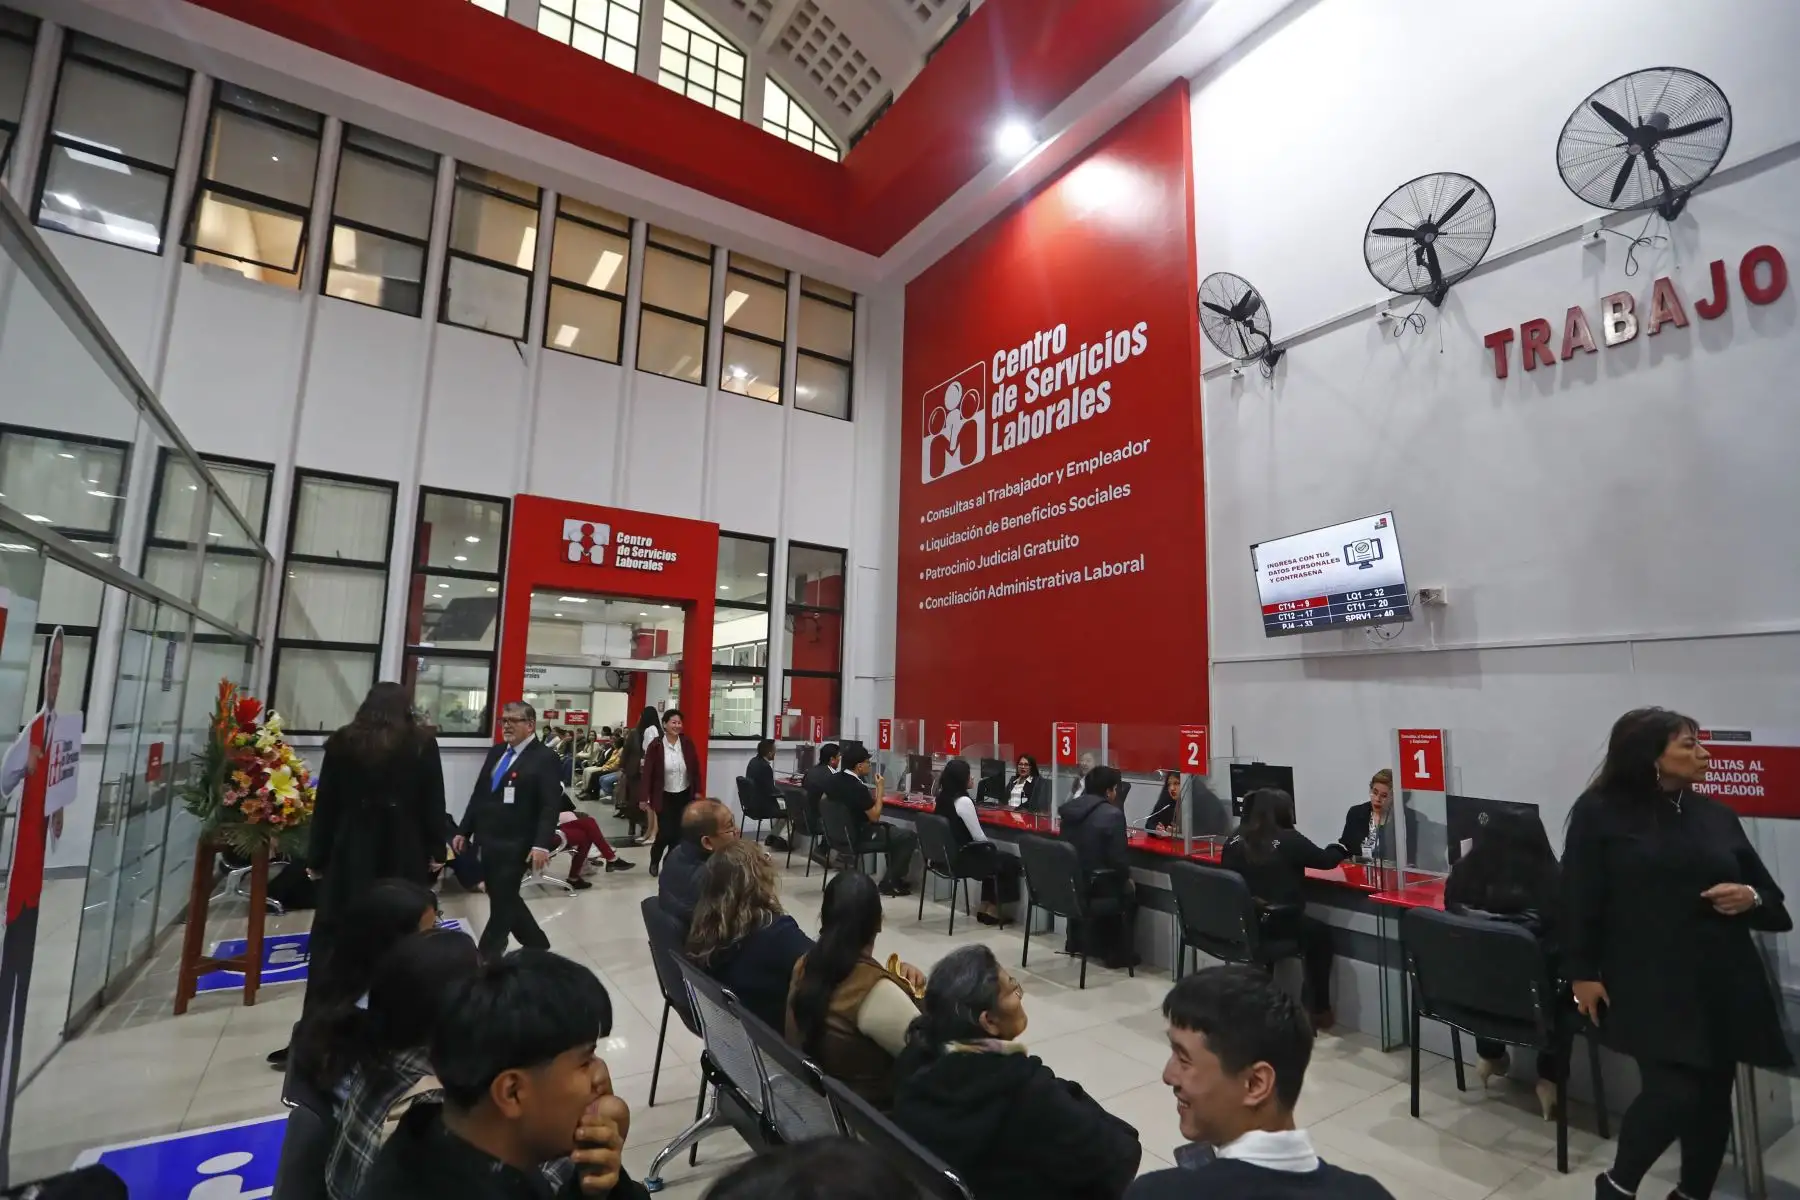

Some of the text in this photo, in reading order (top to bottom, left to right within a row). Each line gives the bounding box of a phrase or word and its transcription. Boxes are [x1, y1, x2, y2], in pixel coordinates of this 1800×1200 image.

[1484, 245, 1787, 379] TRABAJO
[992, 323, 1067, 384] Centro
[991, 321, 1148, 420] de Servicios
[991, 380, 1111, 456] Laborales
[926, 438, 1151, 523] Consultas al Trabajador y Empleador
[926, 483, 1131, 552] Liquidación de Beneficios Sociales
[616, 531, 652, 547] Centro
[617, 544, 677, 562] de Servicios
[925, 533, 1080, 581] Patrocinio Judicial Gratuito
[1266, 551, 1330, 569] INGRESA CON TUS
[615, 556, 664, 571] Laborales
[1268, 557, 1341, 576] DATOS PERSONALES
[925, 553, 1145, 610] Conciliación Administrativa Laboral
[1346, 588, 1385, 601] LQ1 32
[1278, 599, 1310, 611] CT14 9
[1346, 599, 1389, 612] CT11 20
[1278, 609, 1313, 621] CT12 17
[1345, 609, 1395, 622] SPRV1 40
[816, 724, 821, 738] 6
[882, 729, 888, 744] 5
[949, 731, 956, 748] 4
[1062, 735, 1071, 756] 3
[1187, 742, 1199, 765] 2
[1414, 749, 1430, 778] 1
[1708, 759, 1764, 771] ULTAS AL
[1705, 771, 1759, 783] BAJADOR
[1691, 783, 1764, 796] EMPLEADOR
